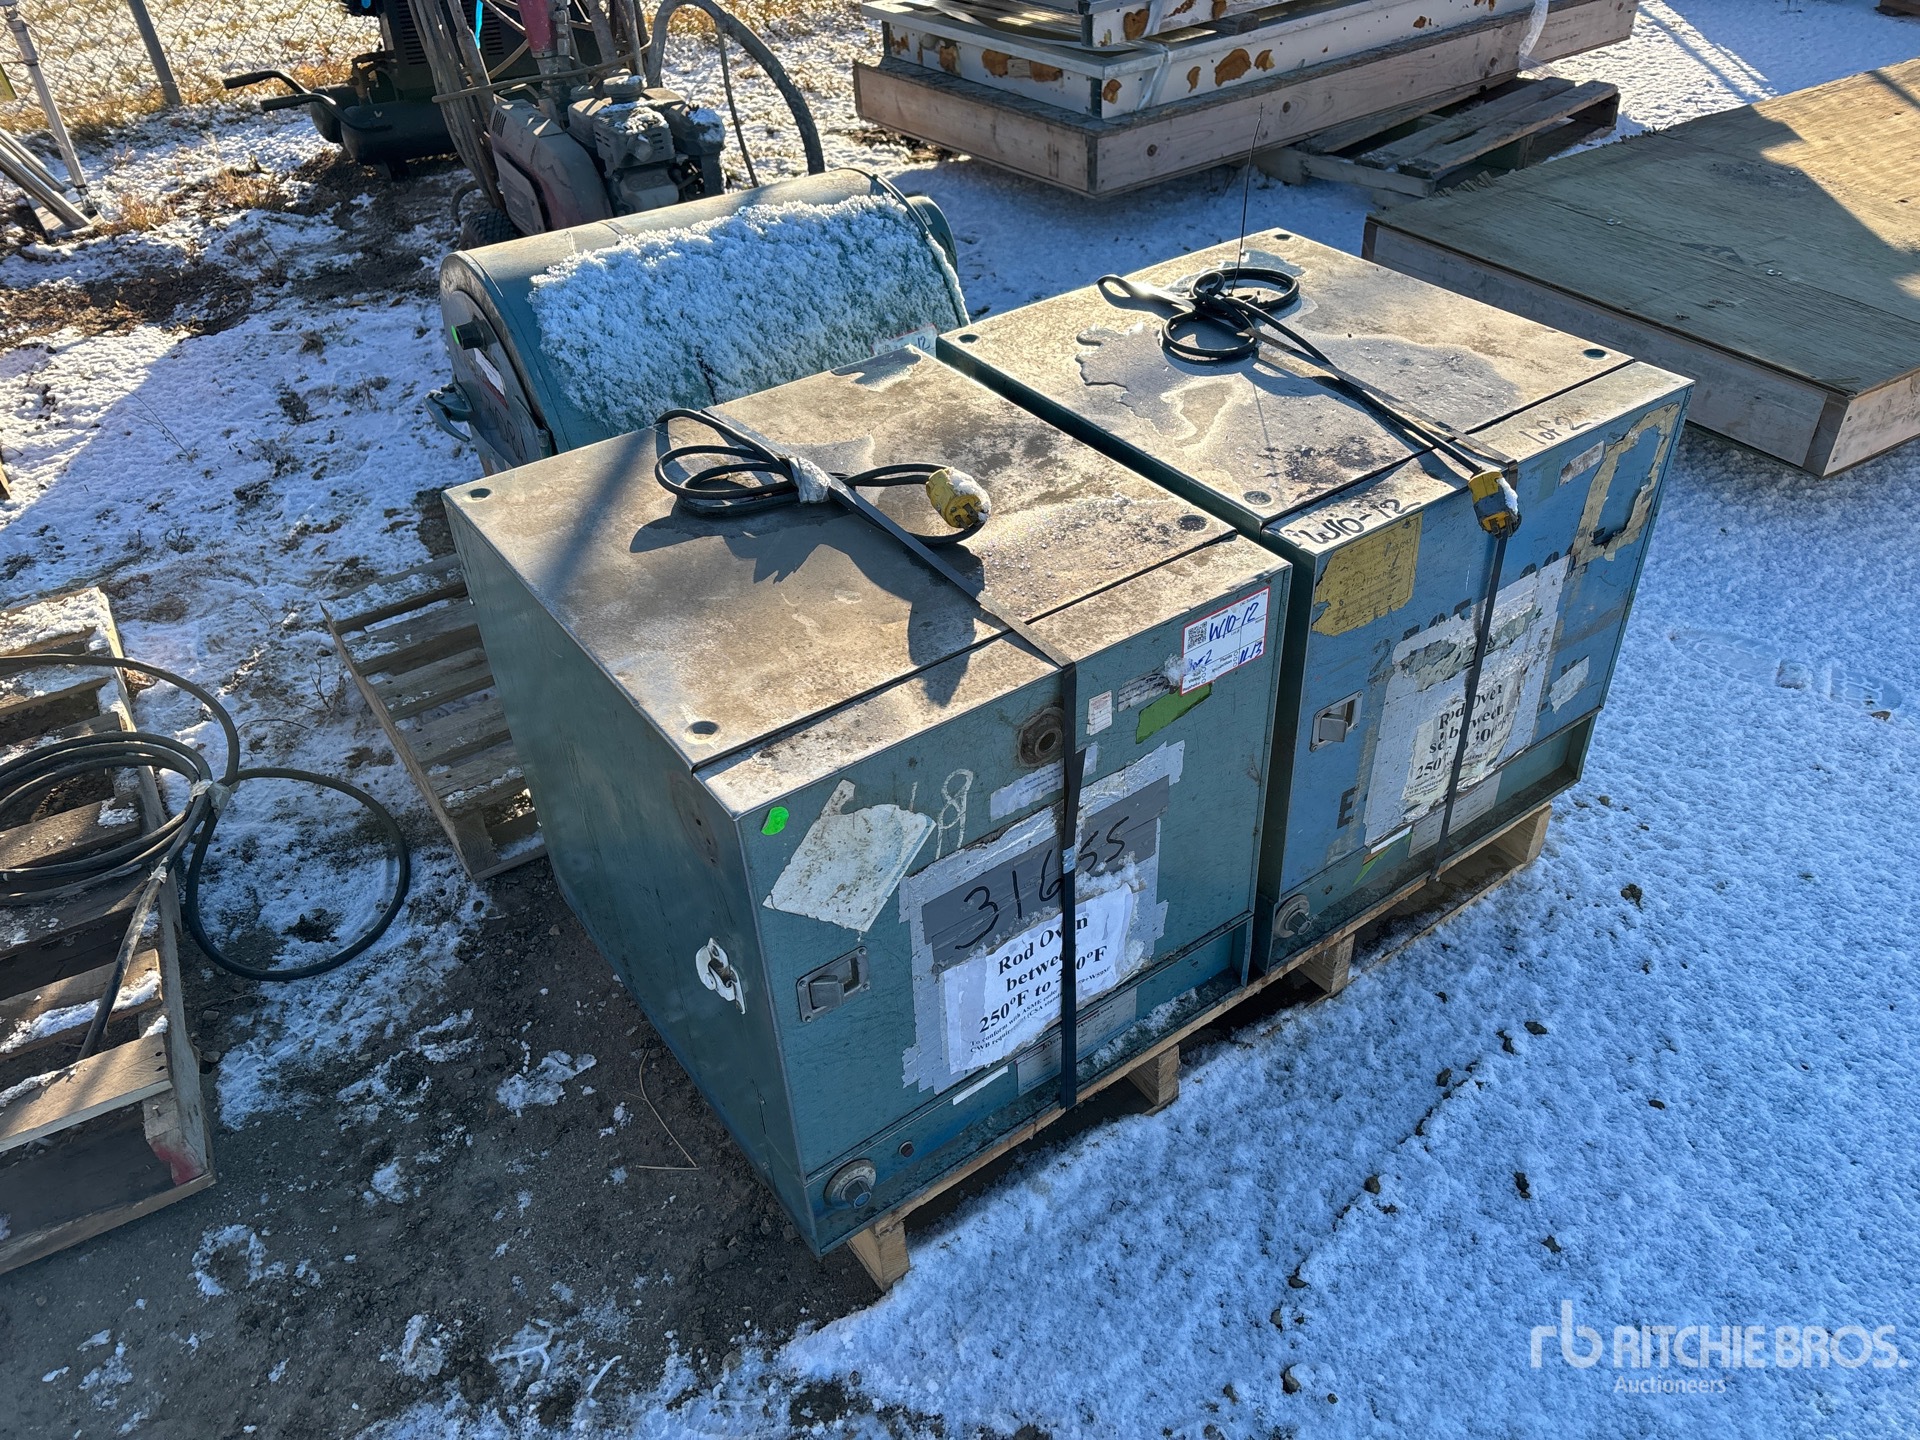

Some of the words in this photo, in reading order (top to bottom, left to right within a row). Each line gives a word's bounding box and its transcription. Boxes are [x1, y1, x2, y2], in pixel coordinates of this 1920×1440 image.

[1208, 602, 1260, 642] W10-12
[998, 942, 1034, 977] Rod
[1040, 917, 1089, 948] Ovn
[1006, 952, 1064, 992] betwe
[1035, 981, 1051, 997] to
[1055, 945, 1108, 984] 30°F
[981, 1023, 1008, 1042] conform
